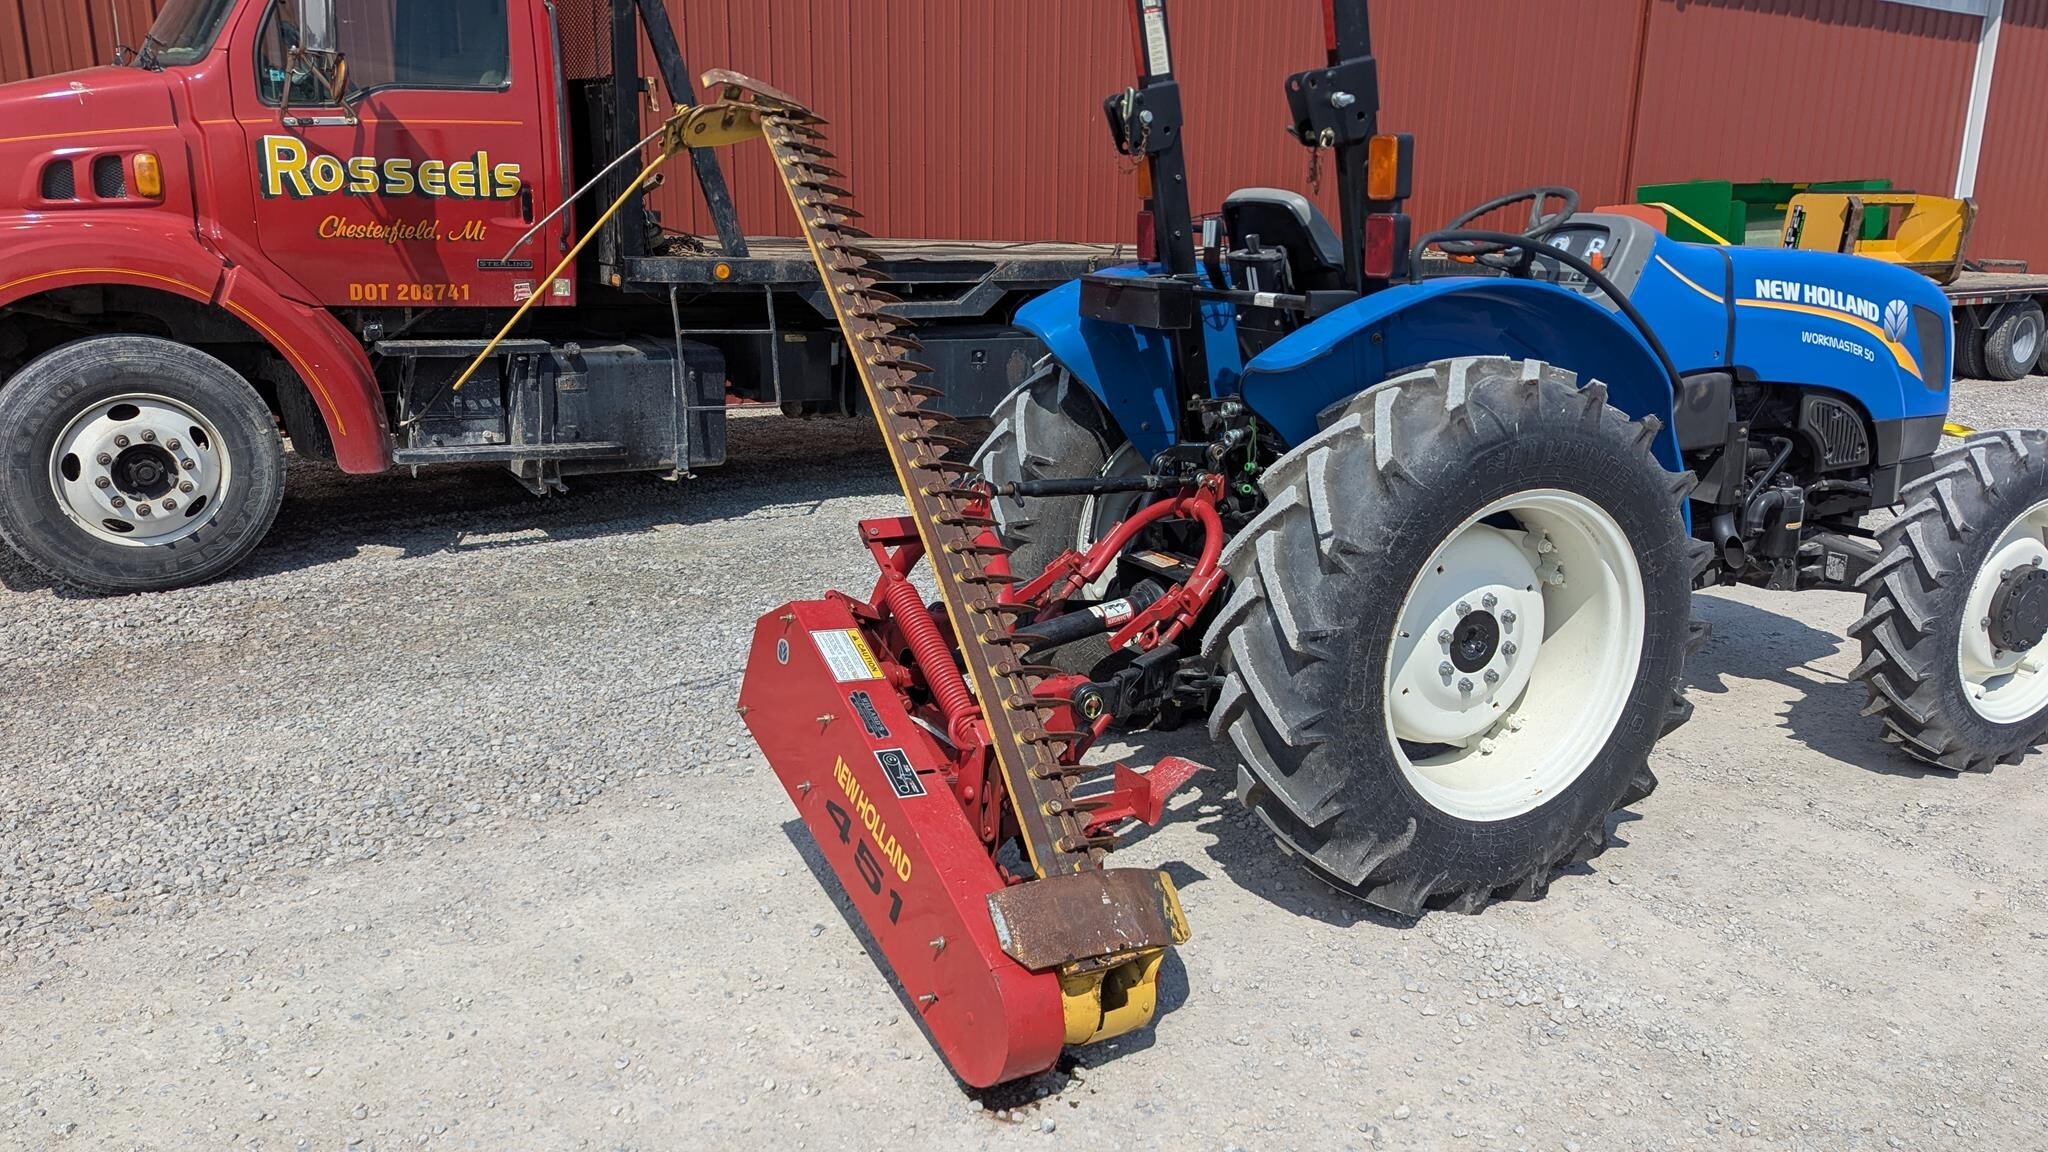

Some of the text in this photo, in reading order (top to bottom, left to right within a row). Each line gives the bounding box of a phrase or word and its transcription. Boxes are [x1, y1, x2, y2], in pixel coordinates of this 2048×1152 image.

[259, 135, 521, 199] Rosseels
[318, 215, 486, 244] Chesterfield, Mi
[350, 283, 470, 301] DOT 208741
[1755, 279, 1880, 322] NEW HOLLAND
[1801, 331, 1875, 362] WORKMASTER 50
[857, 643, 878, 672] CAUTION
[833, 755, 857, 805] NEW
[855, 792, 912, 883] HOLLAND
[826, 800, 904, 926] 451
